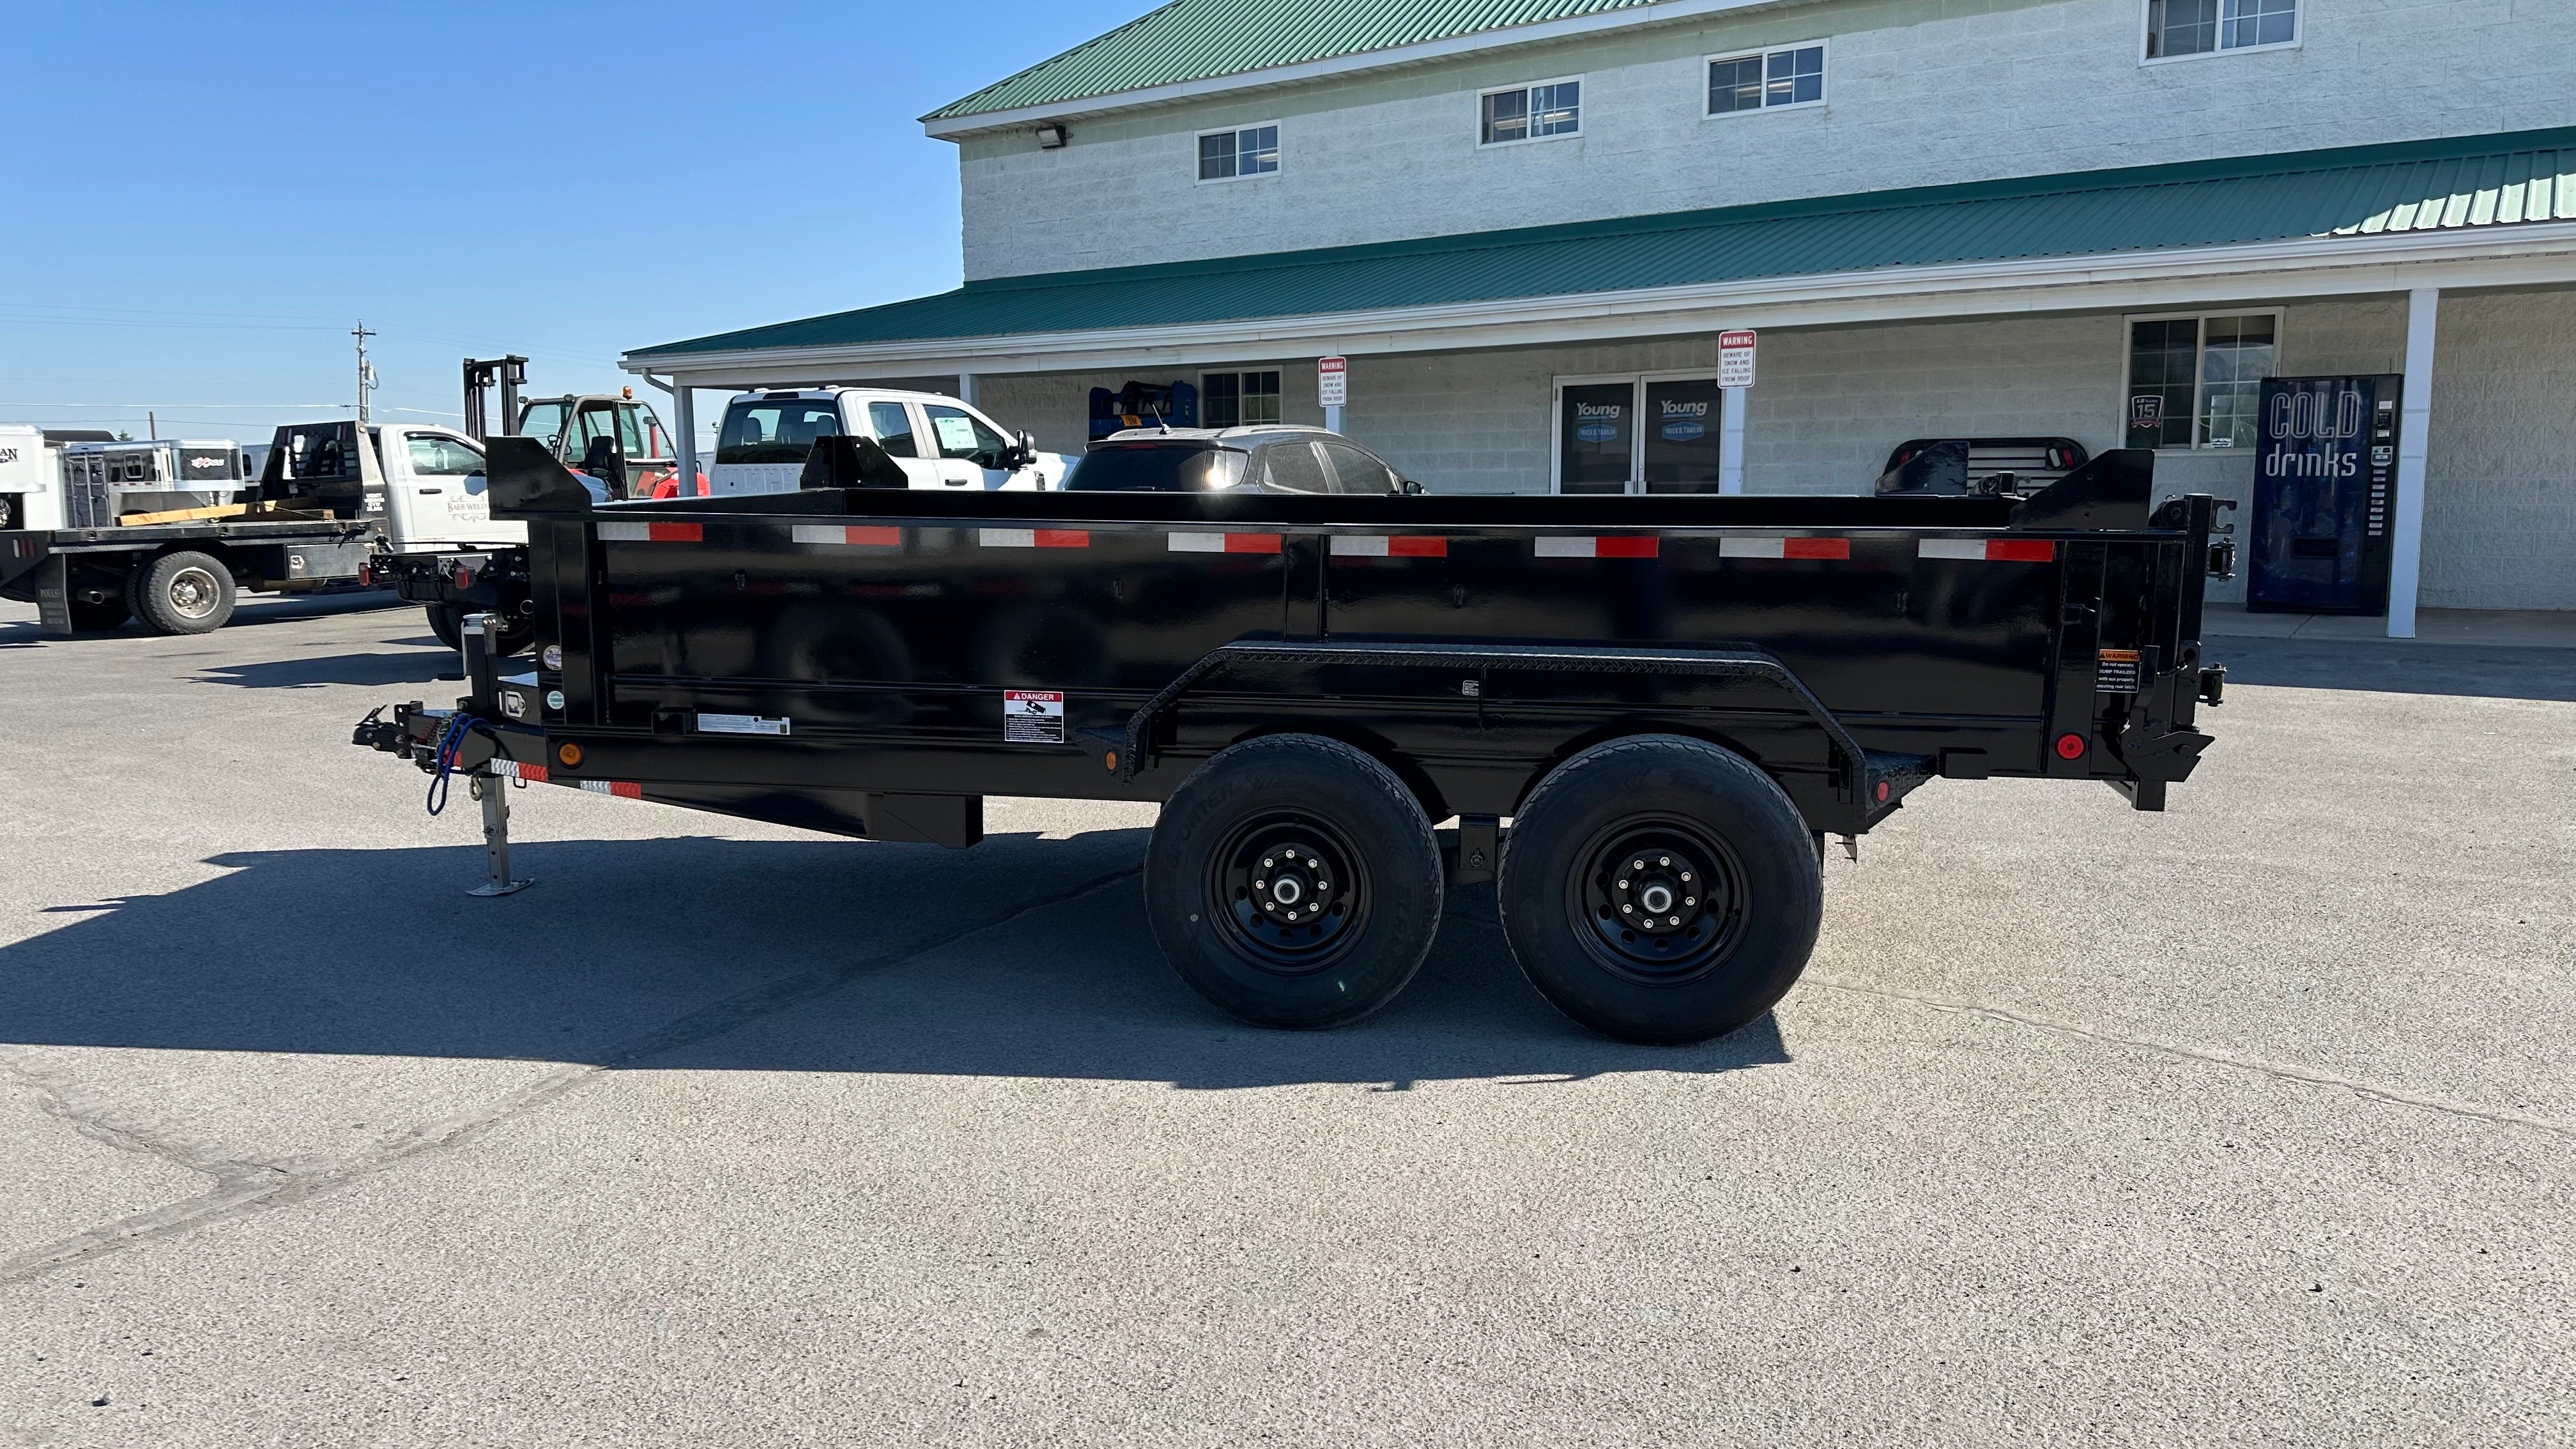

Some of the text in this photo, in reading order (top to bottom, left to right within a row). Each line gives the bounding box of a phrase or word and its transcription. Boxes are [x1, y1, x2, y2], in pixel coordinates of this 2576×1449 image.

[1722, 336, 1752, 346] WARNING
[1321, 362, 1344, 370] WARNING
[1576, 402, 1620, 418] Young
[1661, 400, 1707, 416] Young
[2137, 404, 2155, 418] 15
[2269, 392, 2360, 439] COLD
[2266, 443, 2357, 477] drinks
[448, 503, 465, 512] BAER
